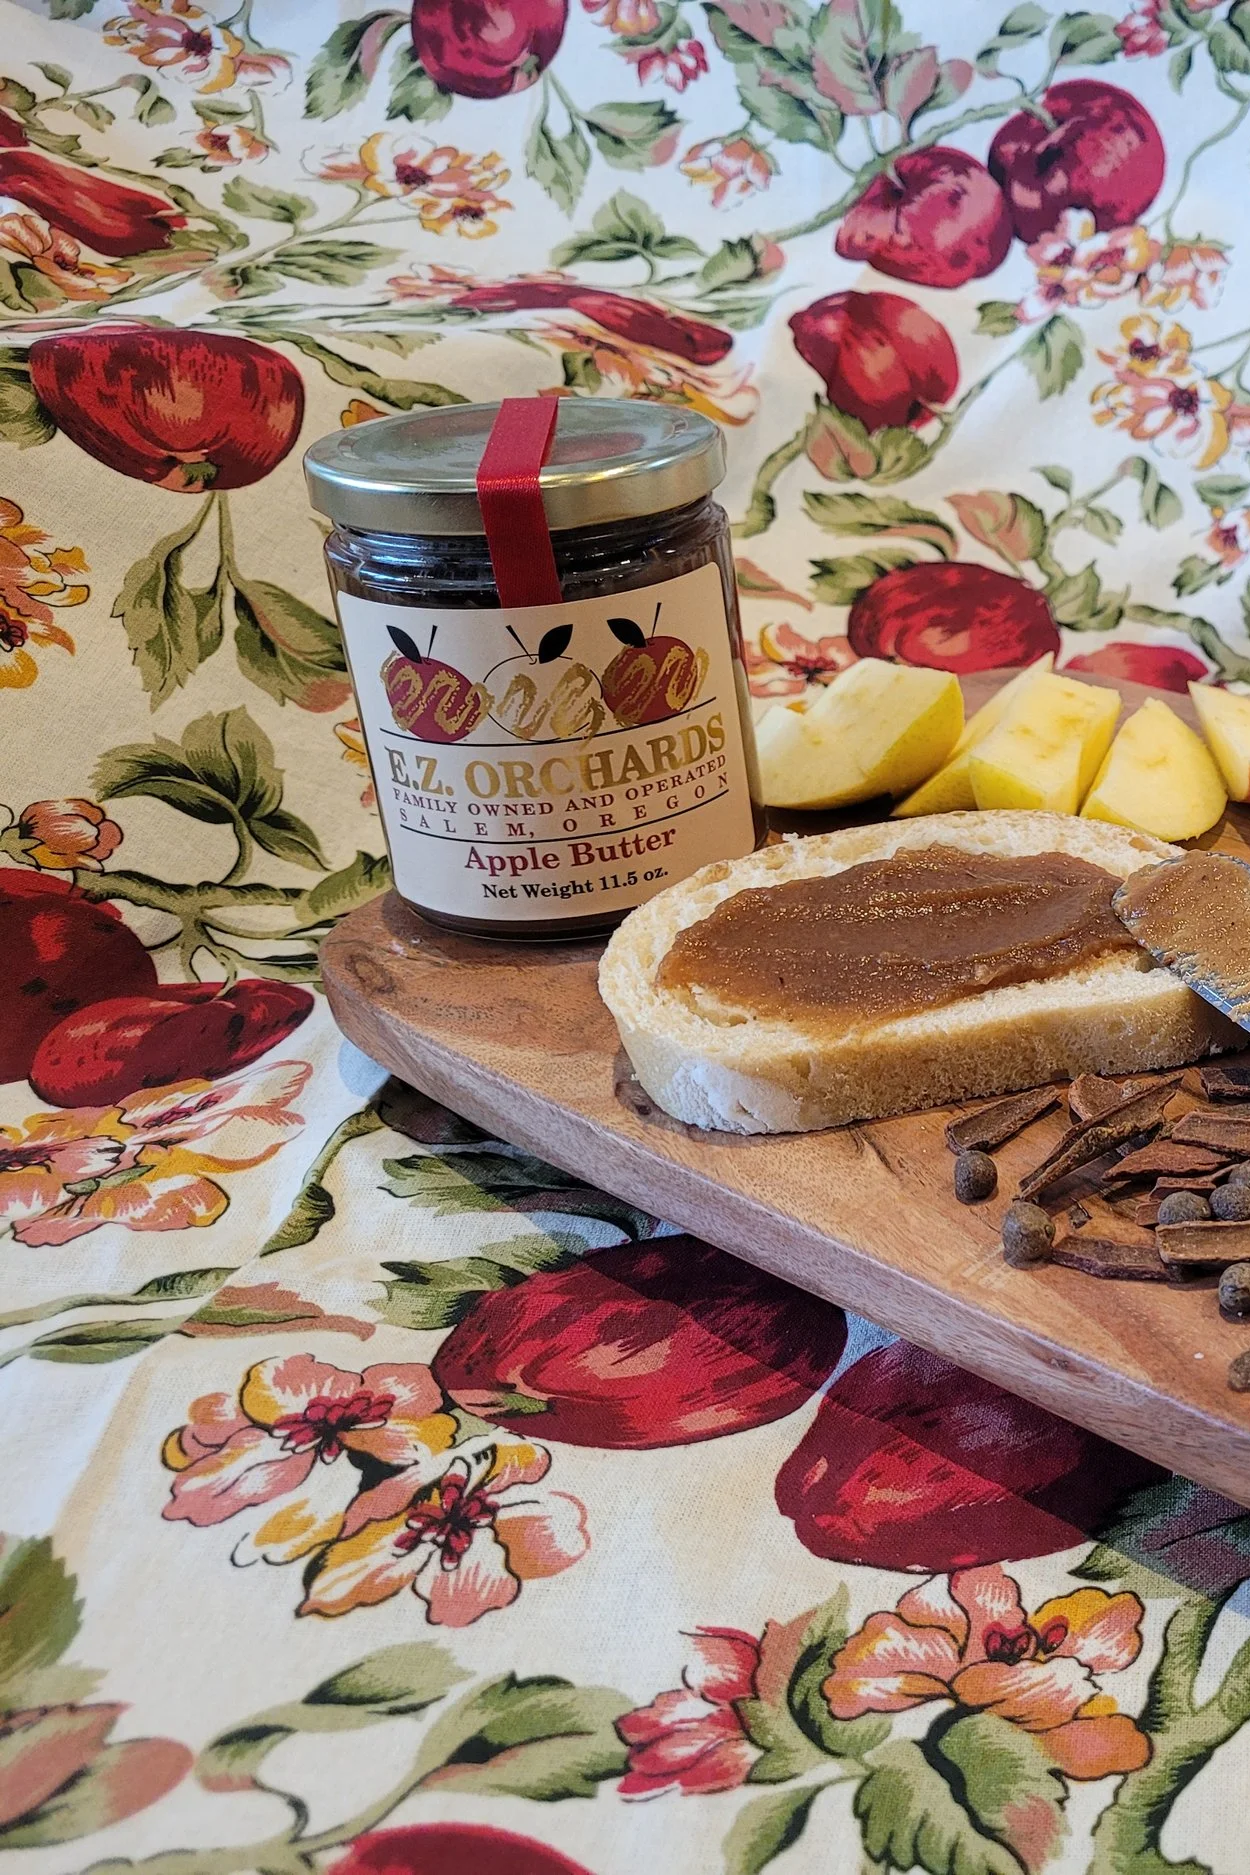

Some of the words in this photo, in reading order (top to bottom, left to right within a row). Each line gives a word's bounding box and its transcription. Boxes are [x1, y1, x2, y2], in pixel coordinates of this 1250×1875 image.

[385, 746, 455, 797] E.Z.
[465, 711, 726, 799] ORCHARDS
[393, 788, 458, 815] FAMILY
[468, 801, 554, 817] OWNED
[565, 793, 615, 813] AND
[625, 754, 727, 801] OPERATED
[562, 772, 730, 833] OREGON
[465, 846, 561, 878] Apple
[570, 826, 677, 867] Butter
[483, 882, 518, 899] Net
[521, 876, 595, 901] Weight
[600, 870, 638, 891] 11.5
[643, 867, 669, 882] oz.
